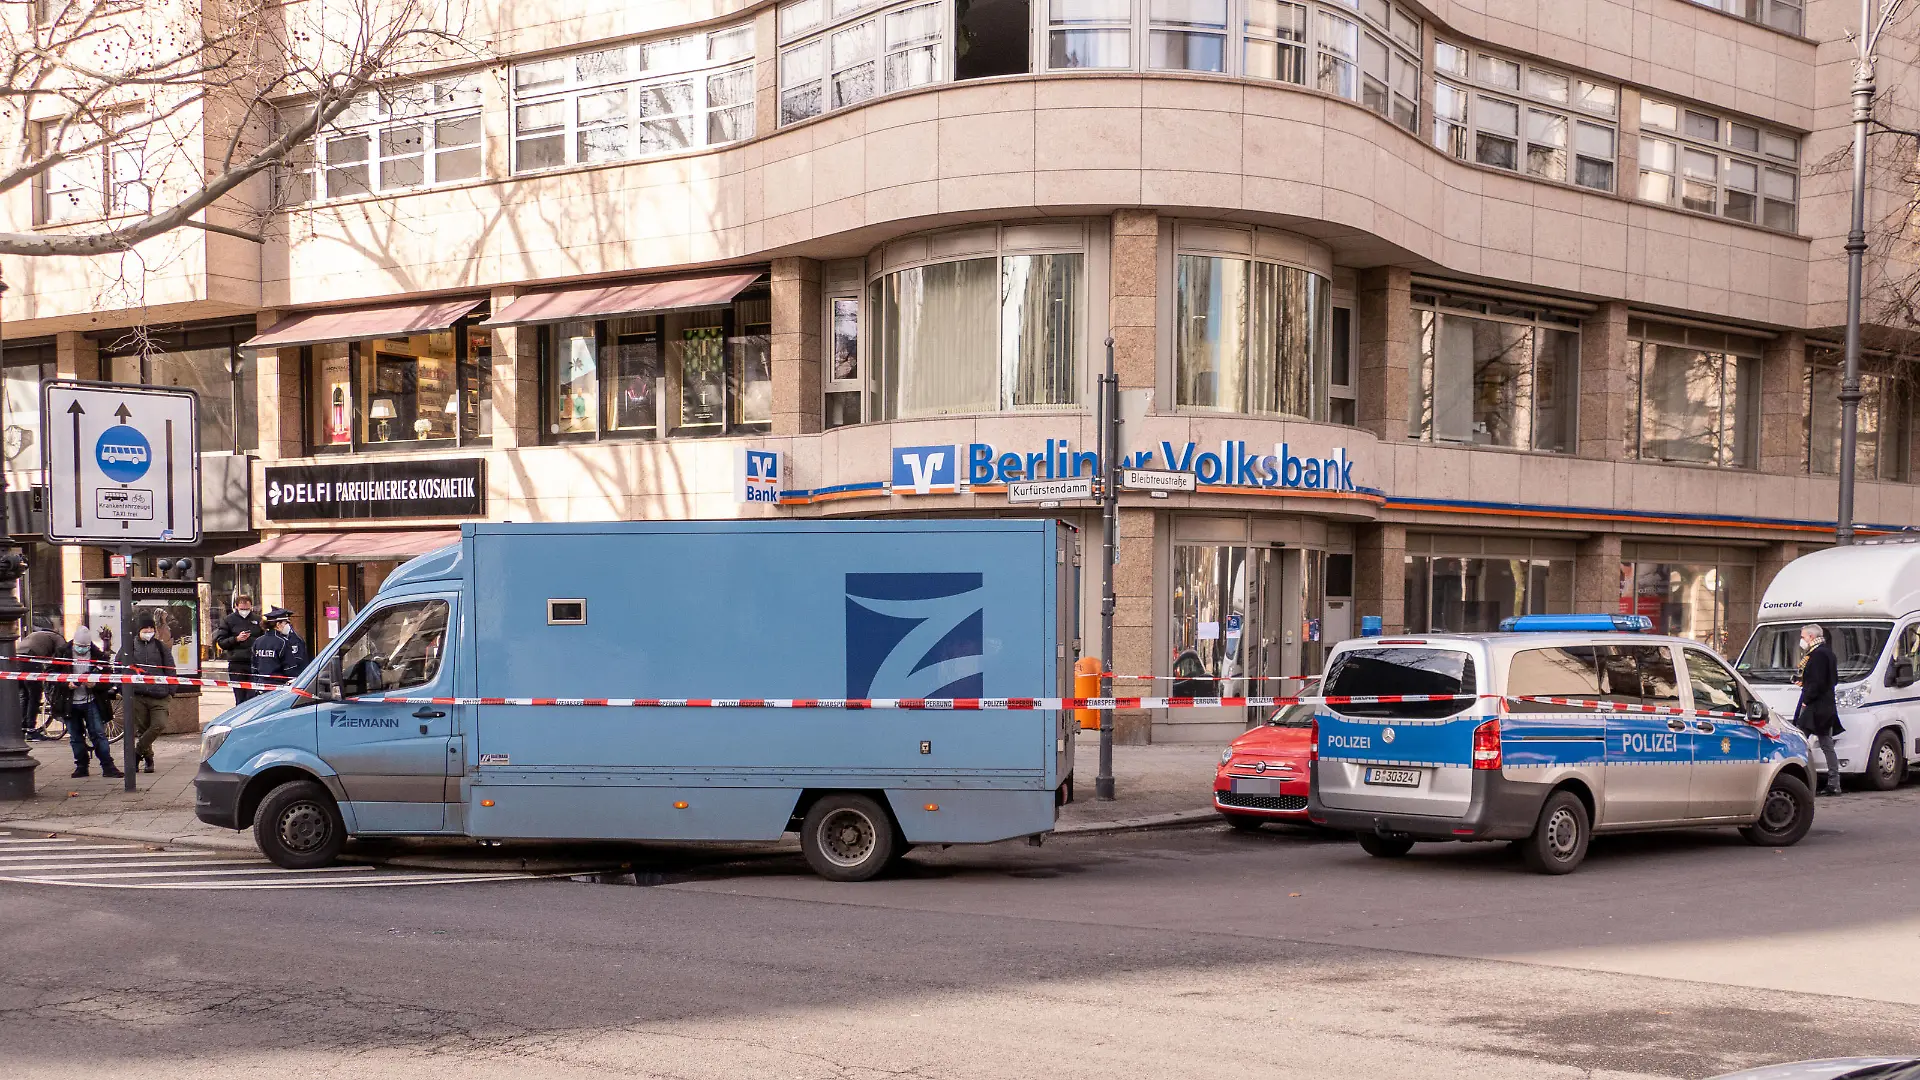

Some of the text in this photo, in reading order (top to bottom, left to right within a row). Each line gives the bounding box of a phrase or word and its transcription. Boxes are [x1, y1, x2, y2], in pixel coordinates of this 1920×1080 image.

[970, 439, 1353, 491] Berlinr Volksbank
[1131, 473, 1187, 488] Bleibtreustraße
[283, 477, 475, 502] DELFI PARFUEMERIE&KOSMETIK
[747, 486, 777, 502] Bank
[1013, 483, 1087, 496] Kurfürstendamm
[1763, 600, 1803, 609] Concorde
[1161, 698, 1219, 706] POLIZEIABSPERRUNG
[1328, 735, 1371, 749] POLIZEI
[1622, 733, 1677, 752] POLIZEI
[1374, 770, 1414, 783] B 30324
